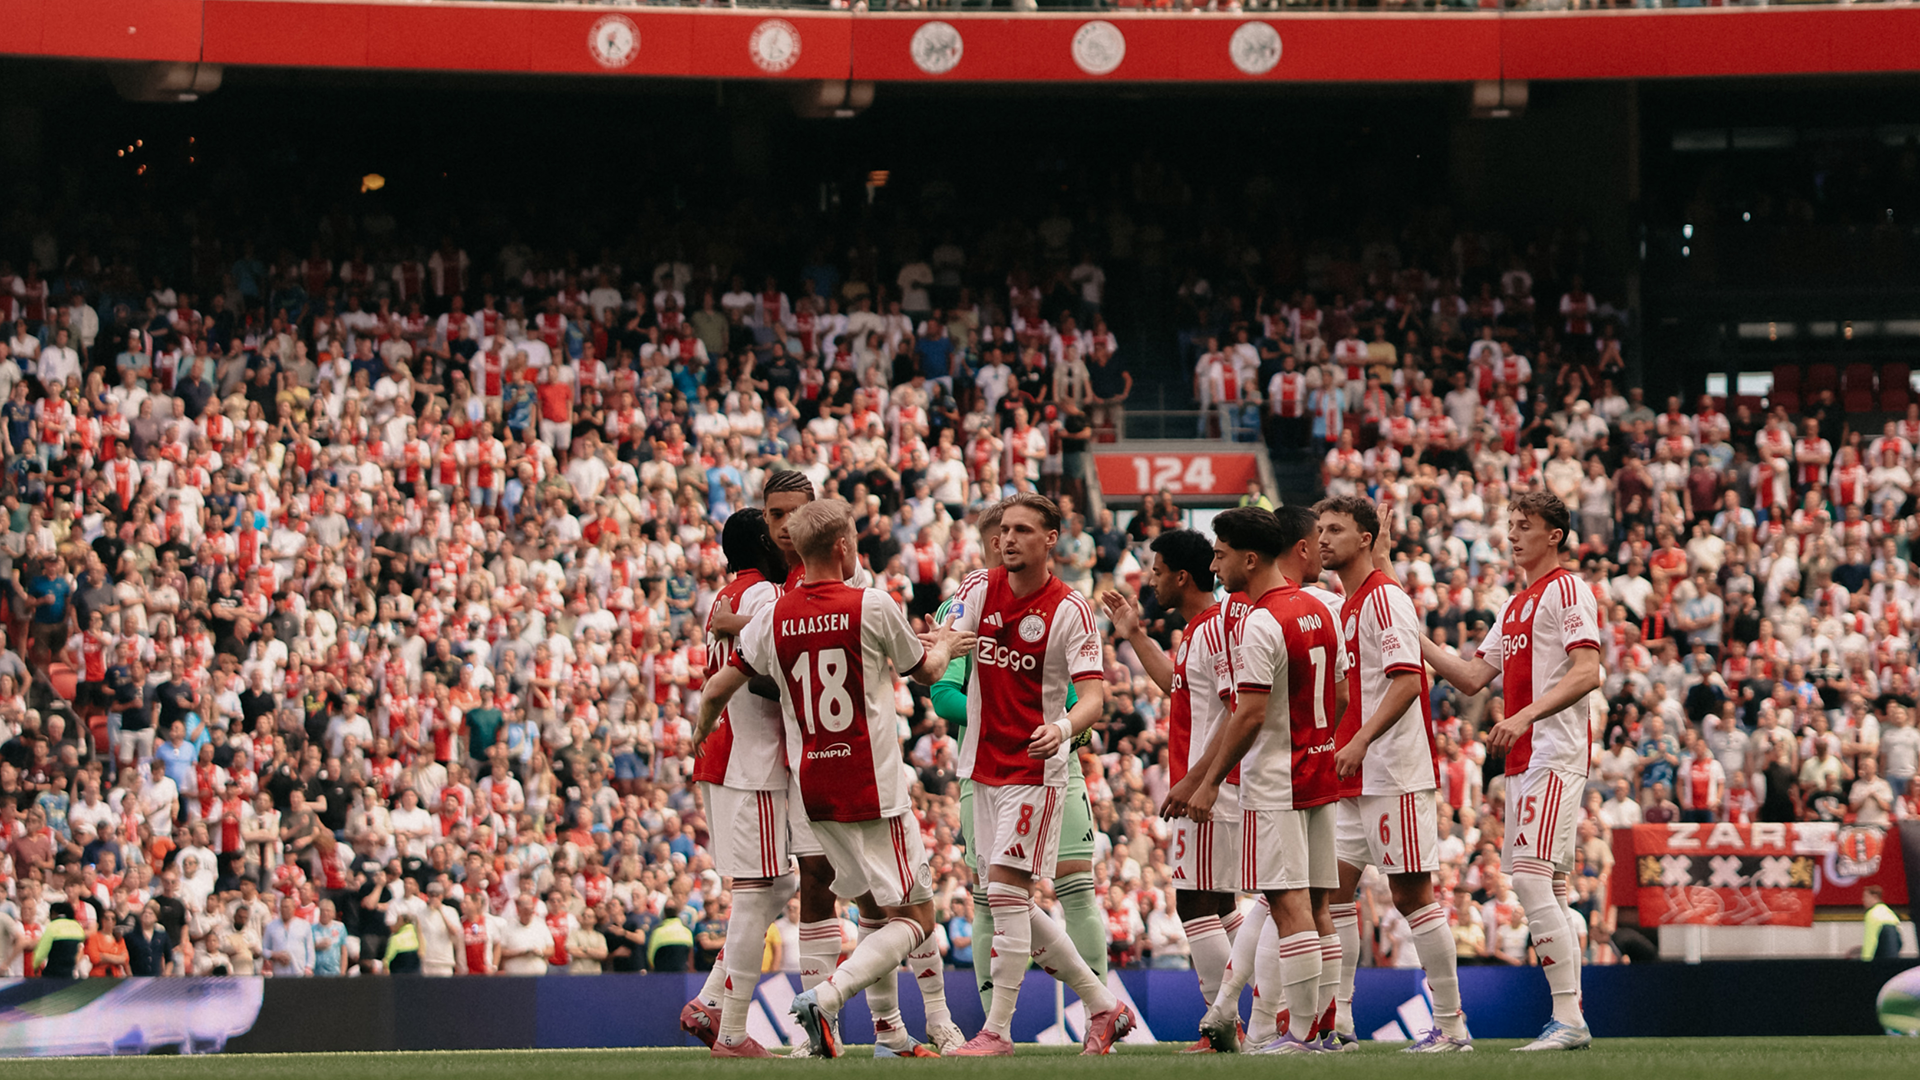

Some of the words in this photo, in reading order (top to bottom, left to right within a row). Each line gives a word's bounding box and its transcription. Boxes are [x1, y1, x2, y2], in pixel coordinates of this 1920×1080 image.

[1132, 456, 1216, 492] 124
[781, 613, 849, 637] KLAASSEN
[1297, 613, 1323, 633] MORO
[1564, 614, 1582, 626] ROCK
[1564, 620, 1584, 632] STARS
[1381, 637, 1398, 647] ROCK
[1382, 643, 1401, 653] STARS
[791, 648, 854, 735] 18
[807, 747, 851, 759] OLYMPIA
[1015, 802, 1034, 837] 8
[1516, 795, 1537, 827] 15
[1379, 812, 1391, 846] 6
[1175, 828, 1186, 861] 5
